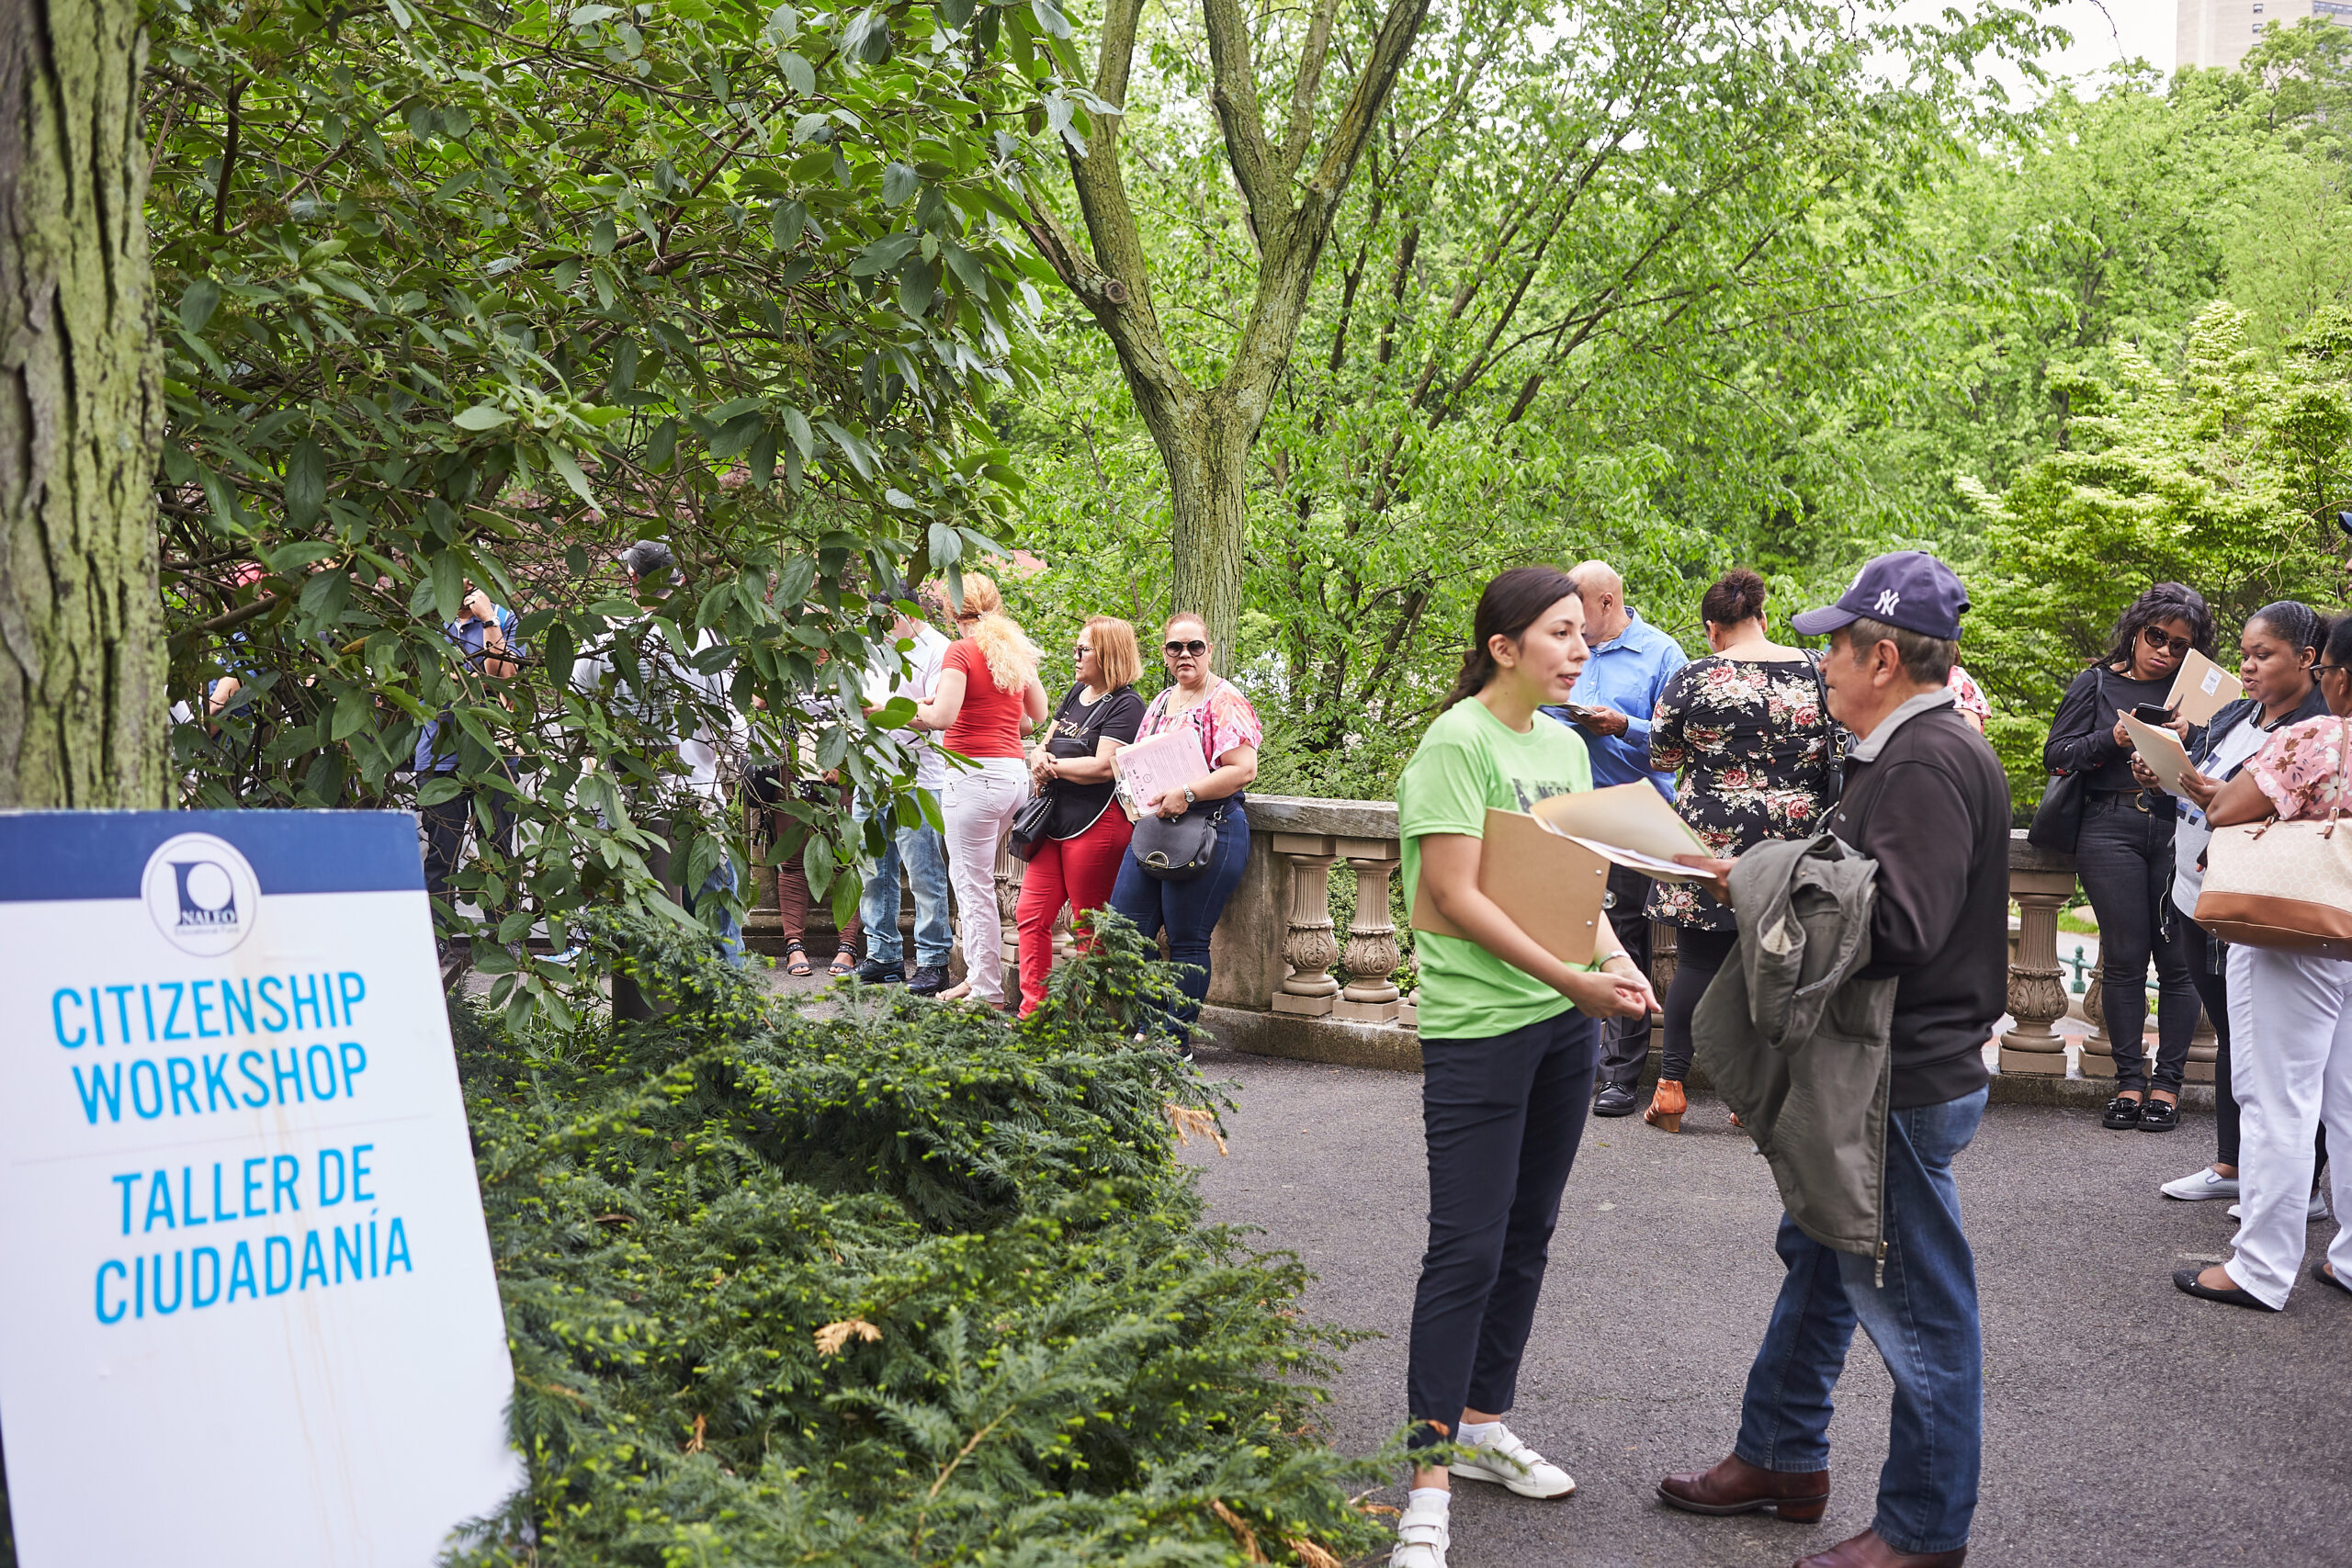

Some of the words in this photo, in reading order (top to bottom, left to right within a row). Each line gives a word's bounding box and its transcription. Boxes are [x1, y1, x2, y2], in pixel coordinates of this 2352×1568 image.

[1874, 589, 1900, 616] NY
[51, 970, 367, 1050] CITIZENSHIP
[71, 1041, 368, 1126] WORKSHOP
[112, 1154, 301, 1237] TALLER
[317, 1143, 376, 1209] DE
[95, 1209, 413, 1326] CIUDADANÍA
